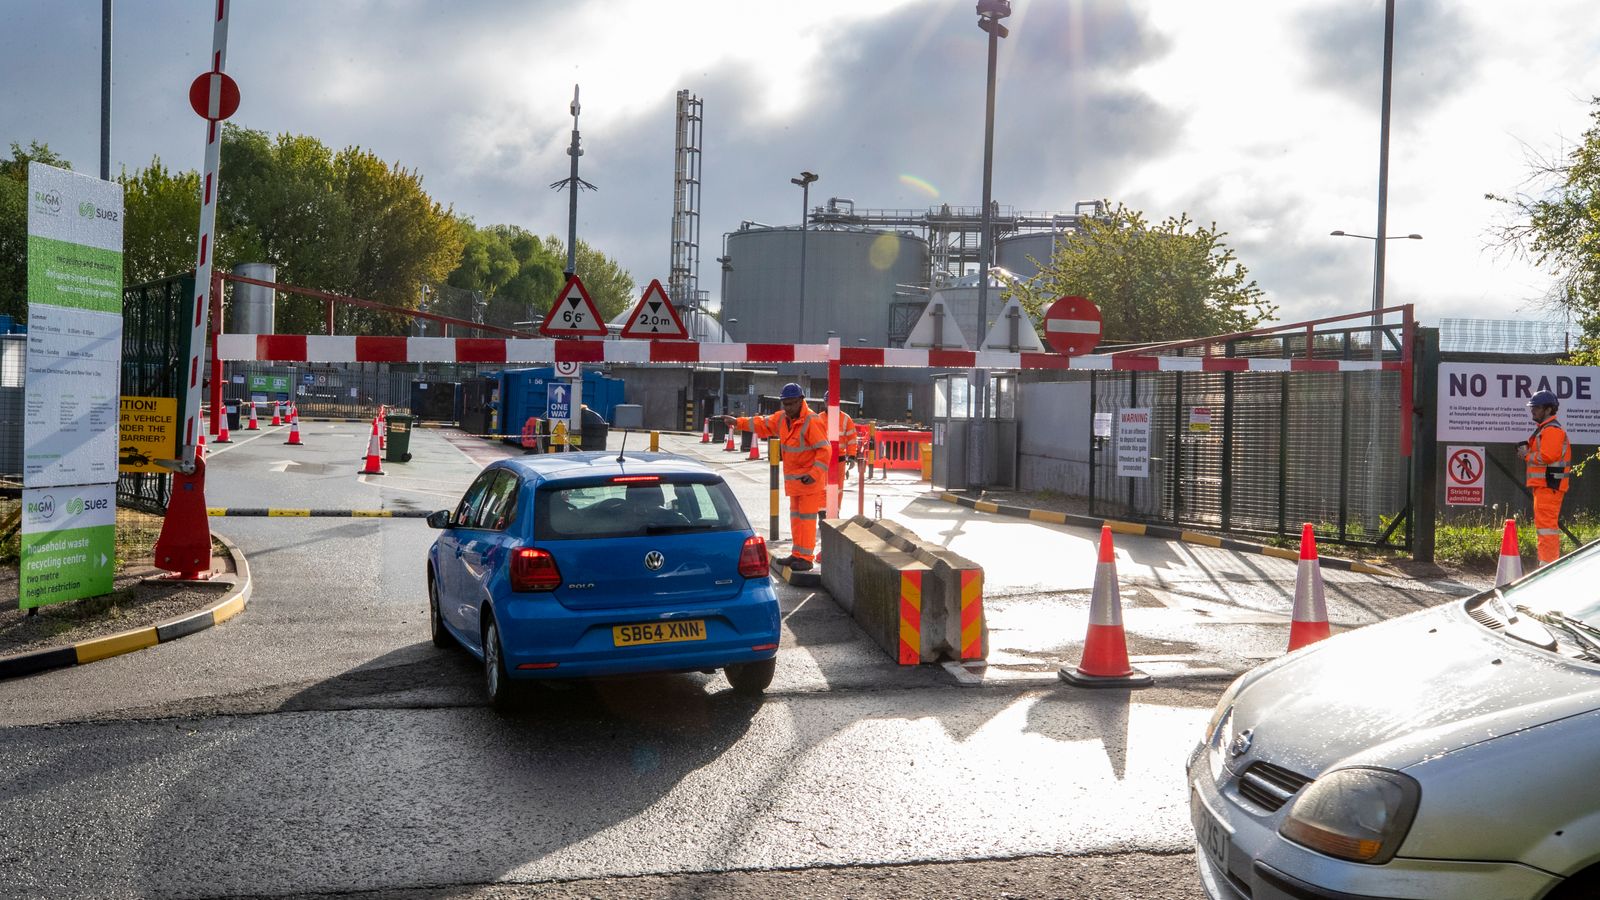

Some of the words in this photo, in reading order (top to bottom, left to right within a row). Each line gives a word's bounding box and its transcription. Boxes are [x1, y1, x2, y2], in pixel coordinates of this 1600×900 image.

[1450, 373, 1487, 397] NO
[1497, 374, 1592, 399] TRADE
[134, 415, 172, 423] VEHICLE
[1121, 413, 1148, 423] WARNING
[148, 425, 165, 433] THE
[121, 435, 166, 443] BARRIER?
[27, 540, 66, 555] household
[67, 537, 90, 550] waste
[27, 555, 62, 571] recycling
[63, 553, 87, 565] centre
[26, 574, 39, 583] two
[40, 571, 59, 581] metre
[26, 586, 46, 598] height
[47, 580, 81, 594] restriction
[621, 625, 664, 642] SB64
[669, 621, 700, 639] XNN
